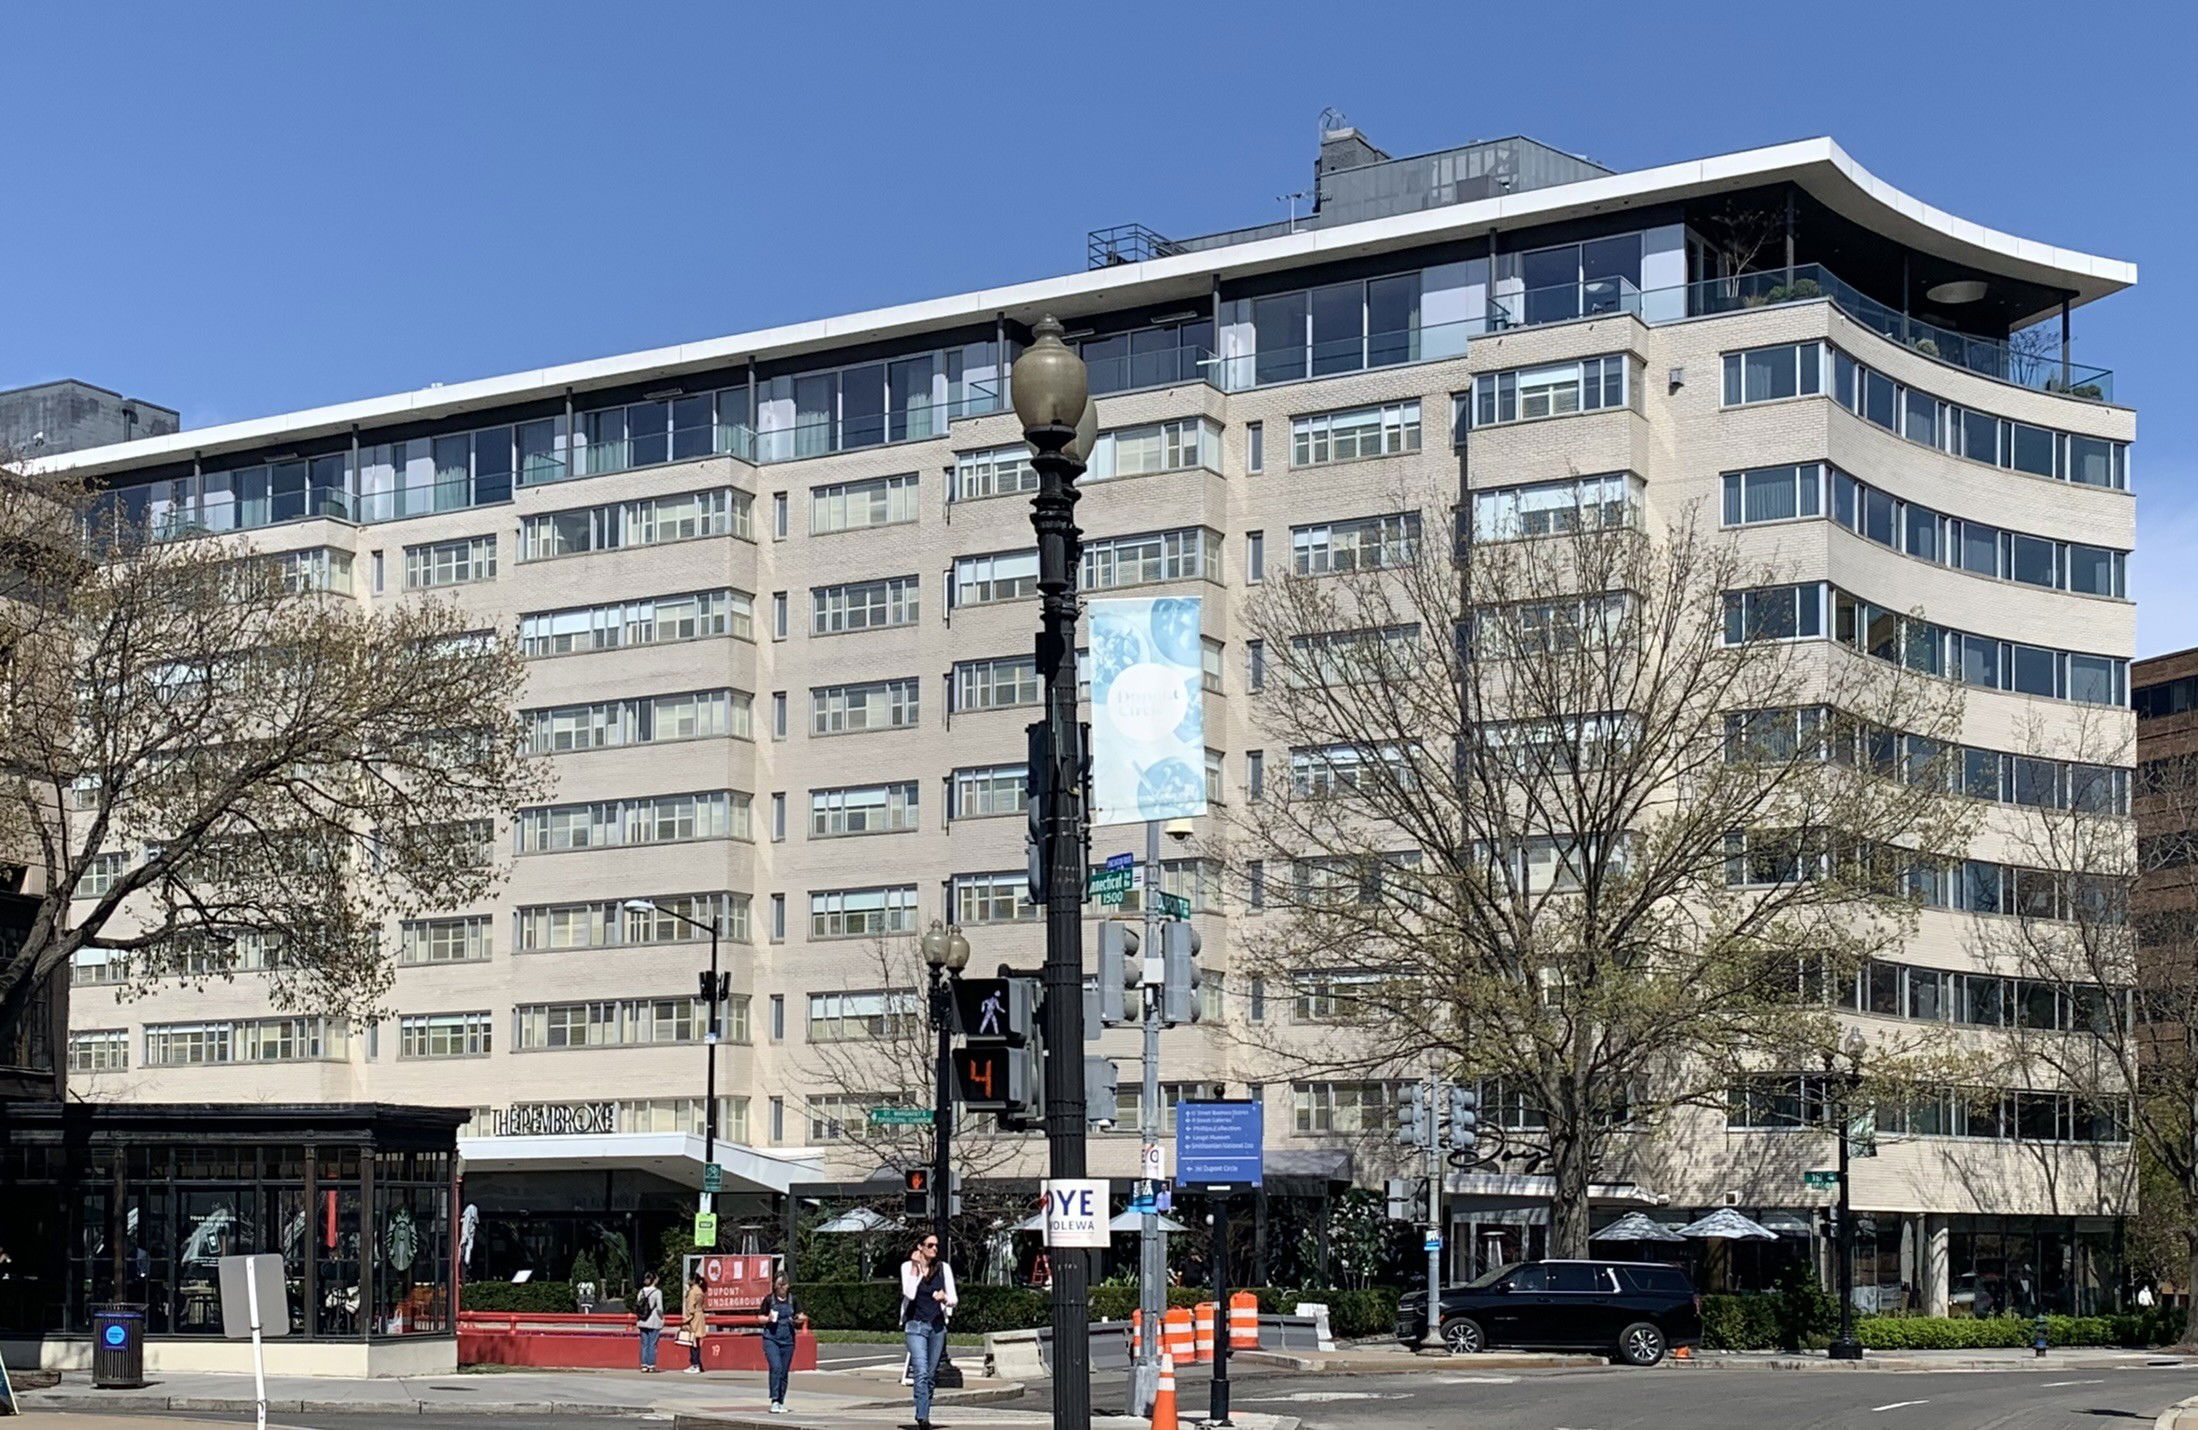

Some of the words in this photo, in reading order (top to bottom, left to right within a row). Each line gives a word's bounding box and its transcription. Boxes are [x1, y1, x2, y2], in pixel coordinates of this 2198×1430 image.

[1089, 872, 1123, 894] nnecticut
[1103, 891, 1123, 904] 1500
[970, 1060, 992, 1098] 4
[491, 1108, 520, 1136] THE
[520, 1104, 613, 1135] PEMBROKE
[708, 1287, 740, 1296] DUPONT
